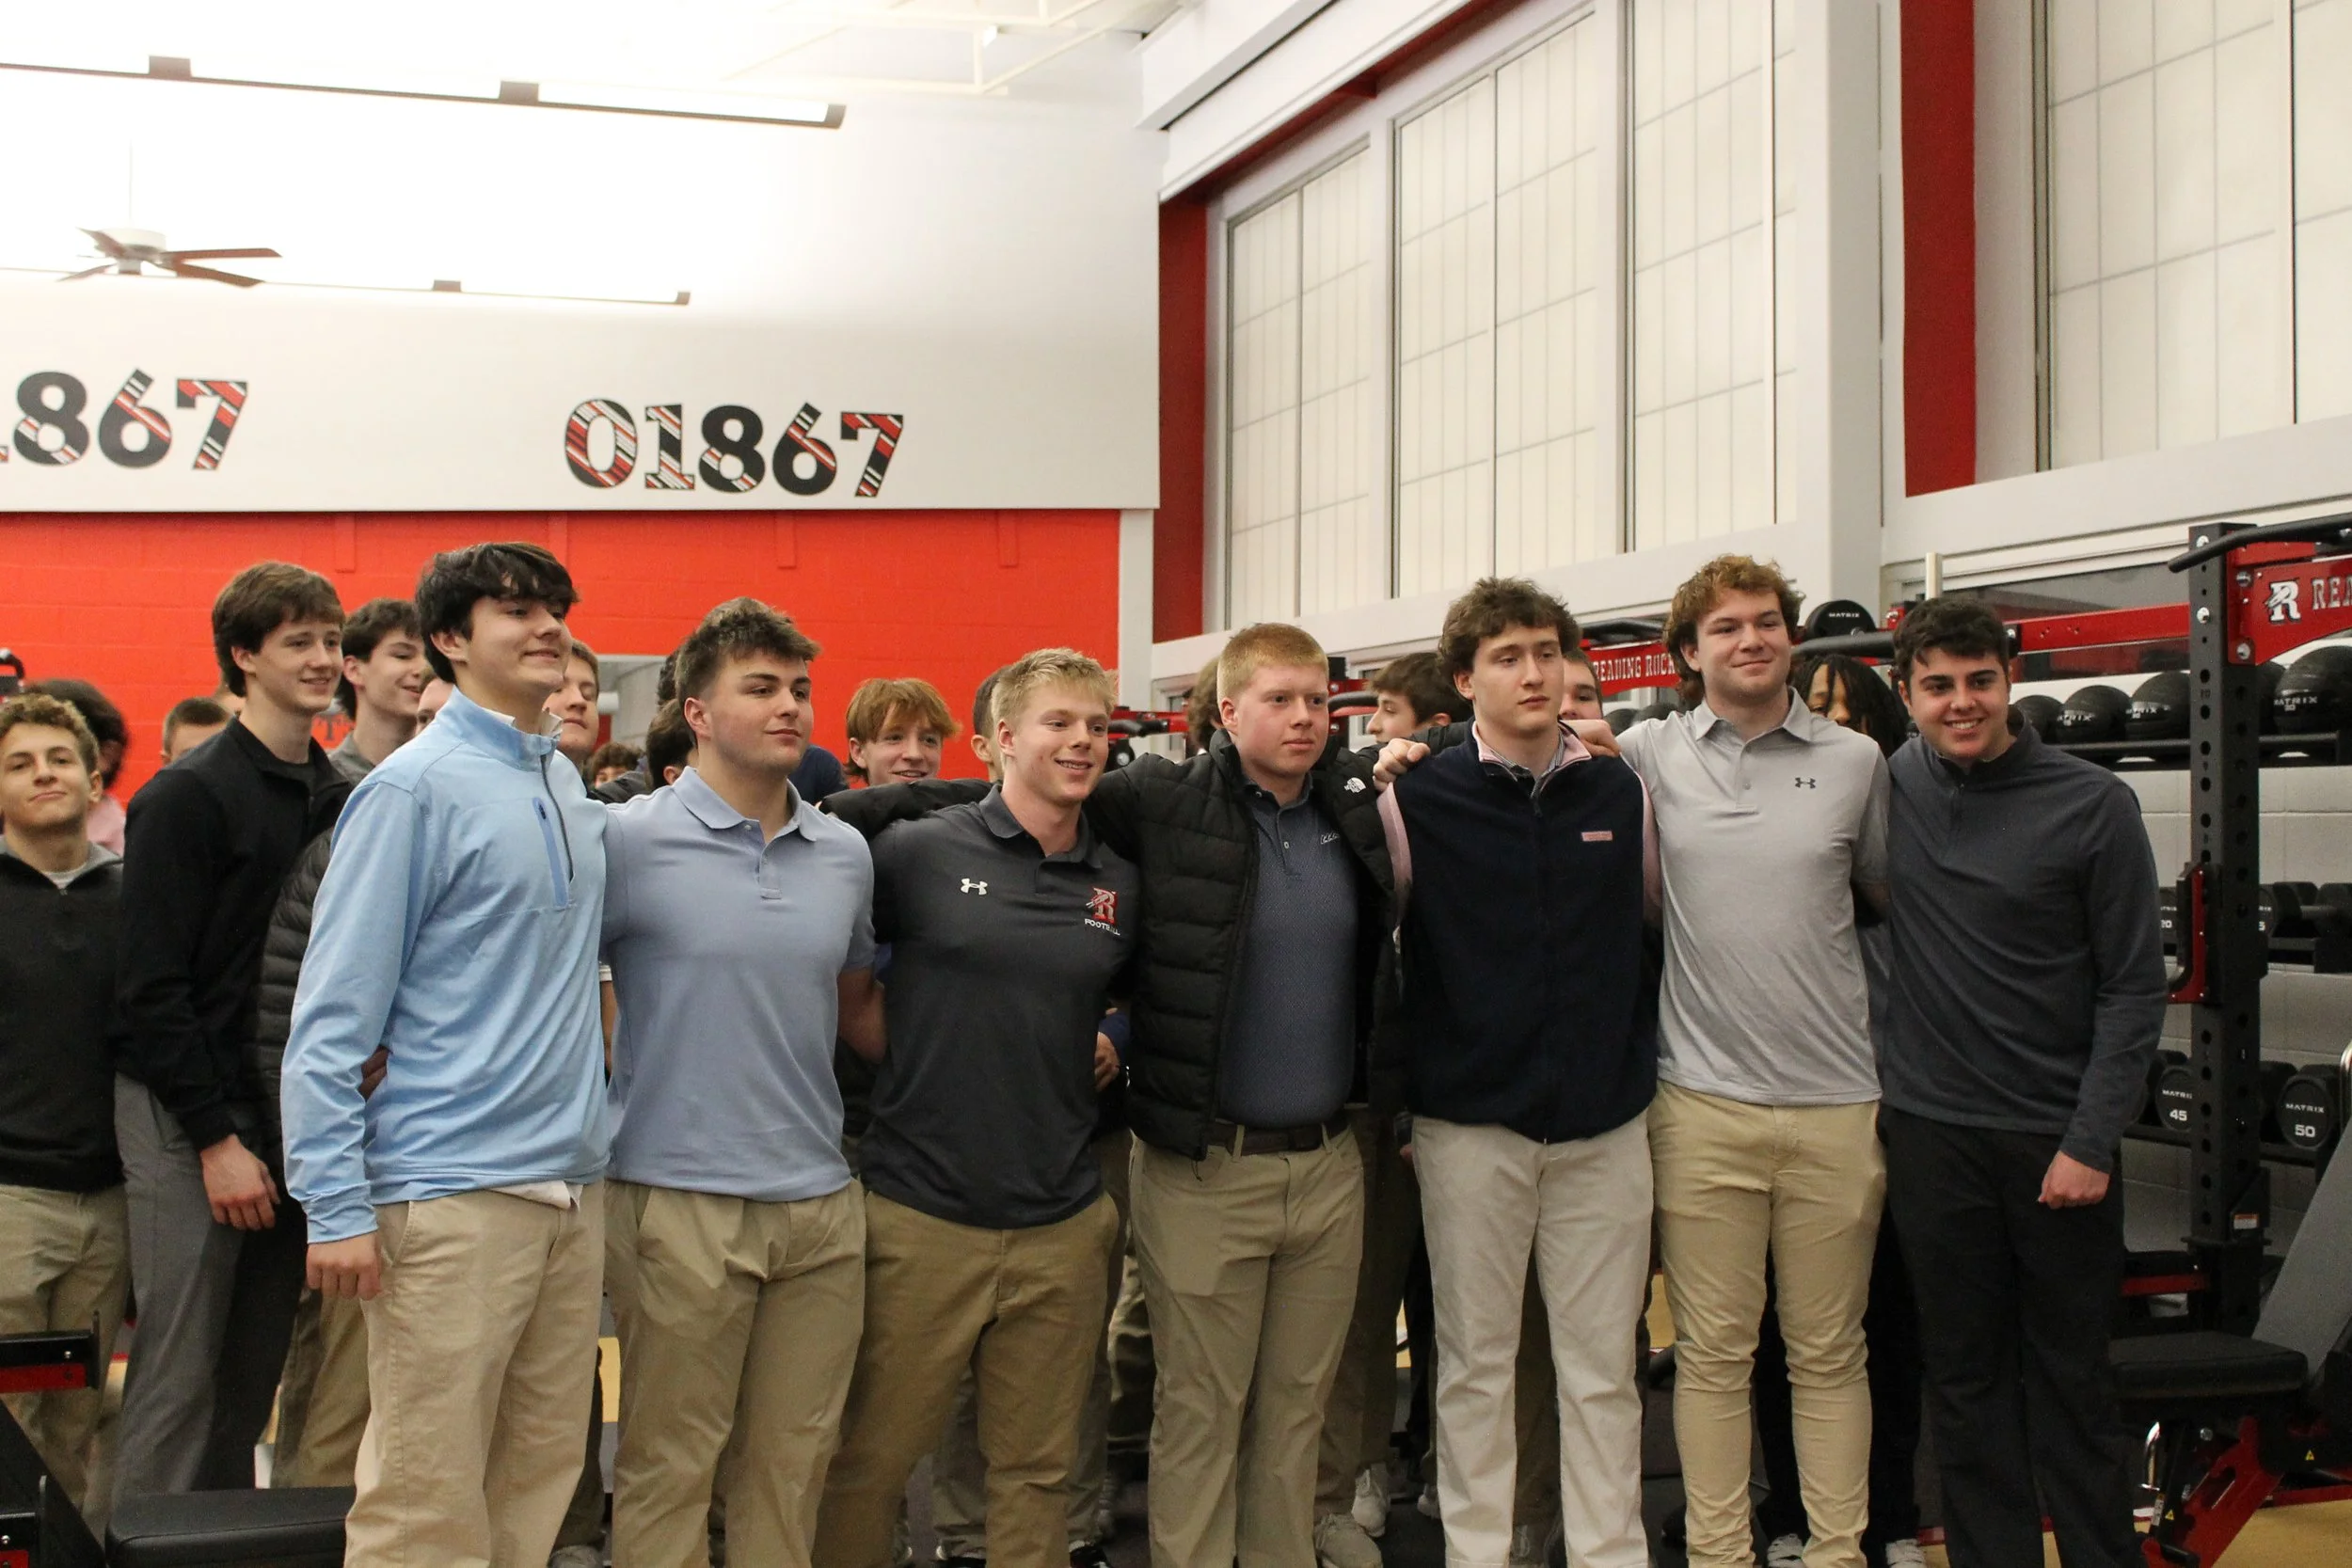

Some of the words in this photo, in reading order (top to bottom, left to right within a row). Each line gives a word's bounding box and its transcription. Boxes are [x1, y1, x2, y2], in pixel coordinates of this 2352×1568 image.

[0, 368, 248, 471] 867
[564, 399, 904, 498] 01867
[2169, 1109, 2187, 1122] 45
[2285, 1102, 2325, 1114] MATRIX
[2295, 1123, 2316, 1138] 50
